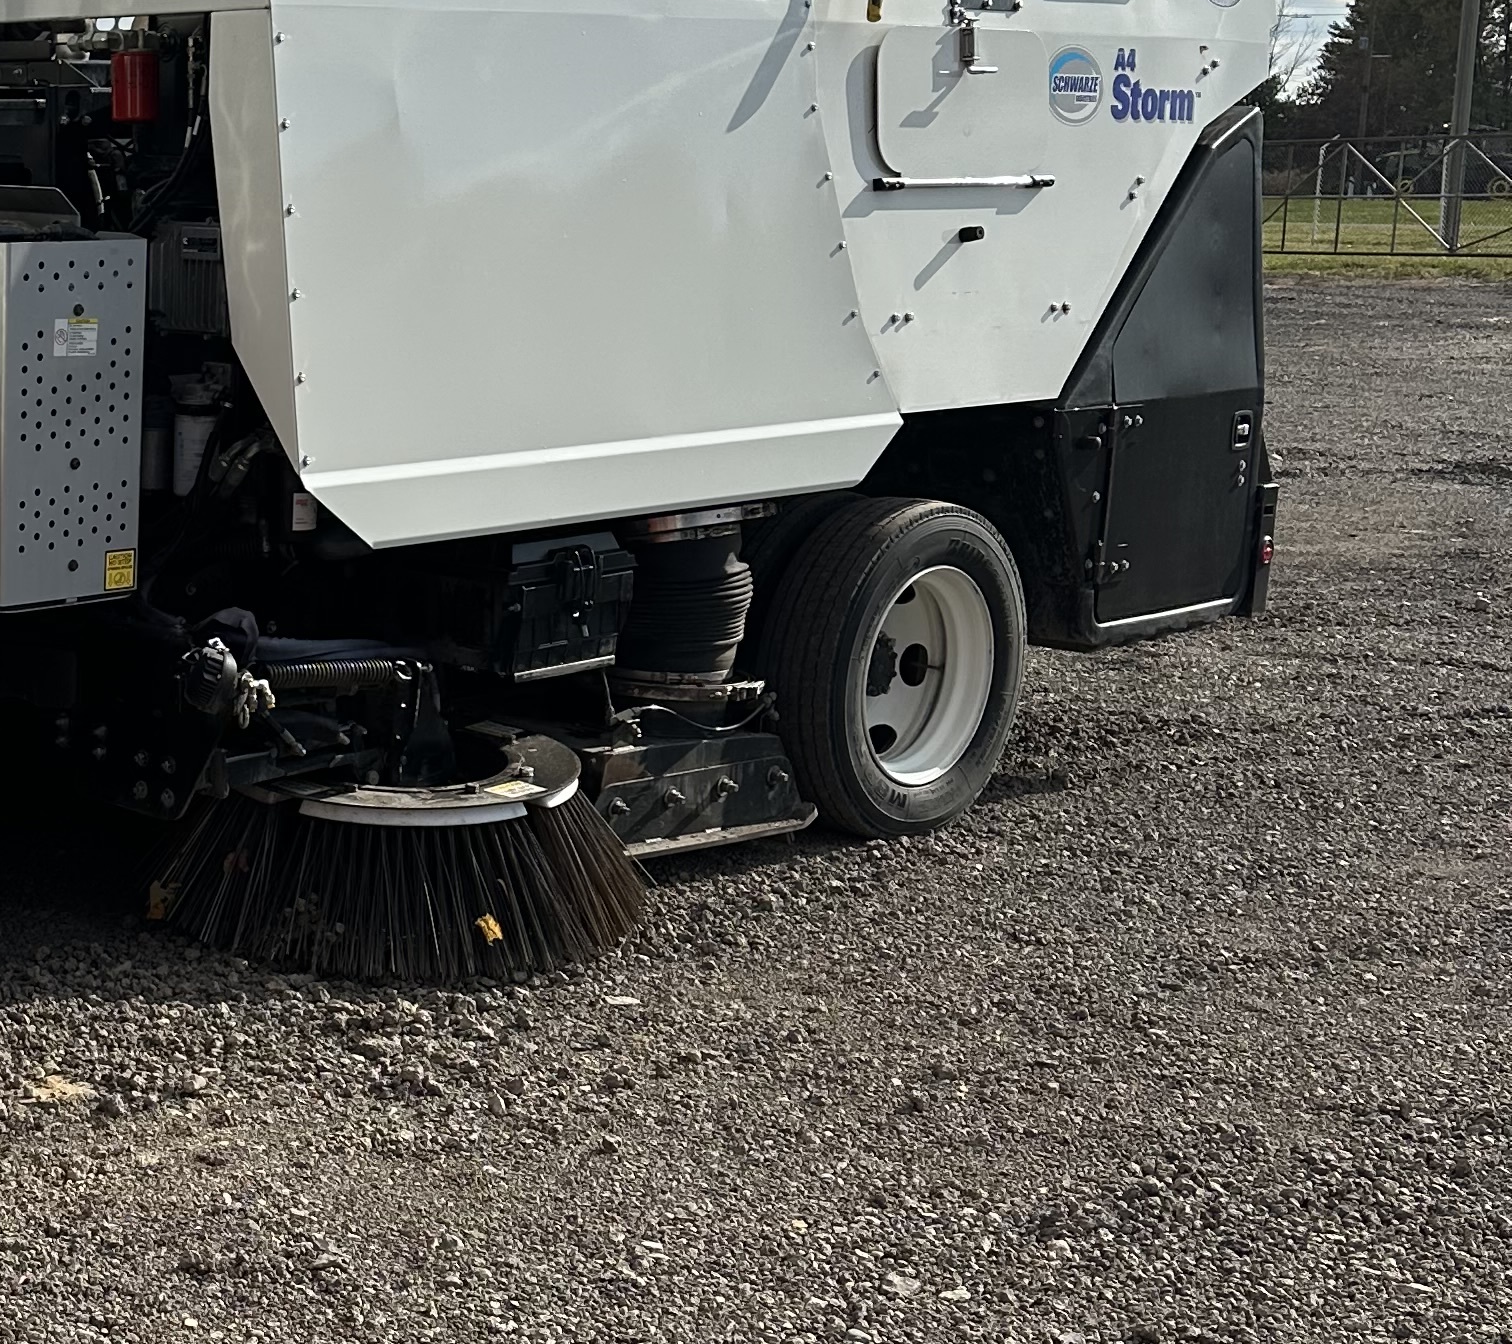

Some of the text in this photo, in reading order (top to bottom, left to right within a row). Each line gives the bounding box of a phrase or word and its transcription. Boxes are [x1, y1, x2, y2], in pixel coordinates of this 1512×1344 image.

[1114, 48, 1136, 71] A4
[1052, 74, 1100, 93] SCHWARZE
[1111, 74, 1195, 121] Storm
